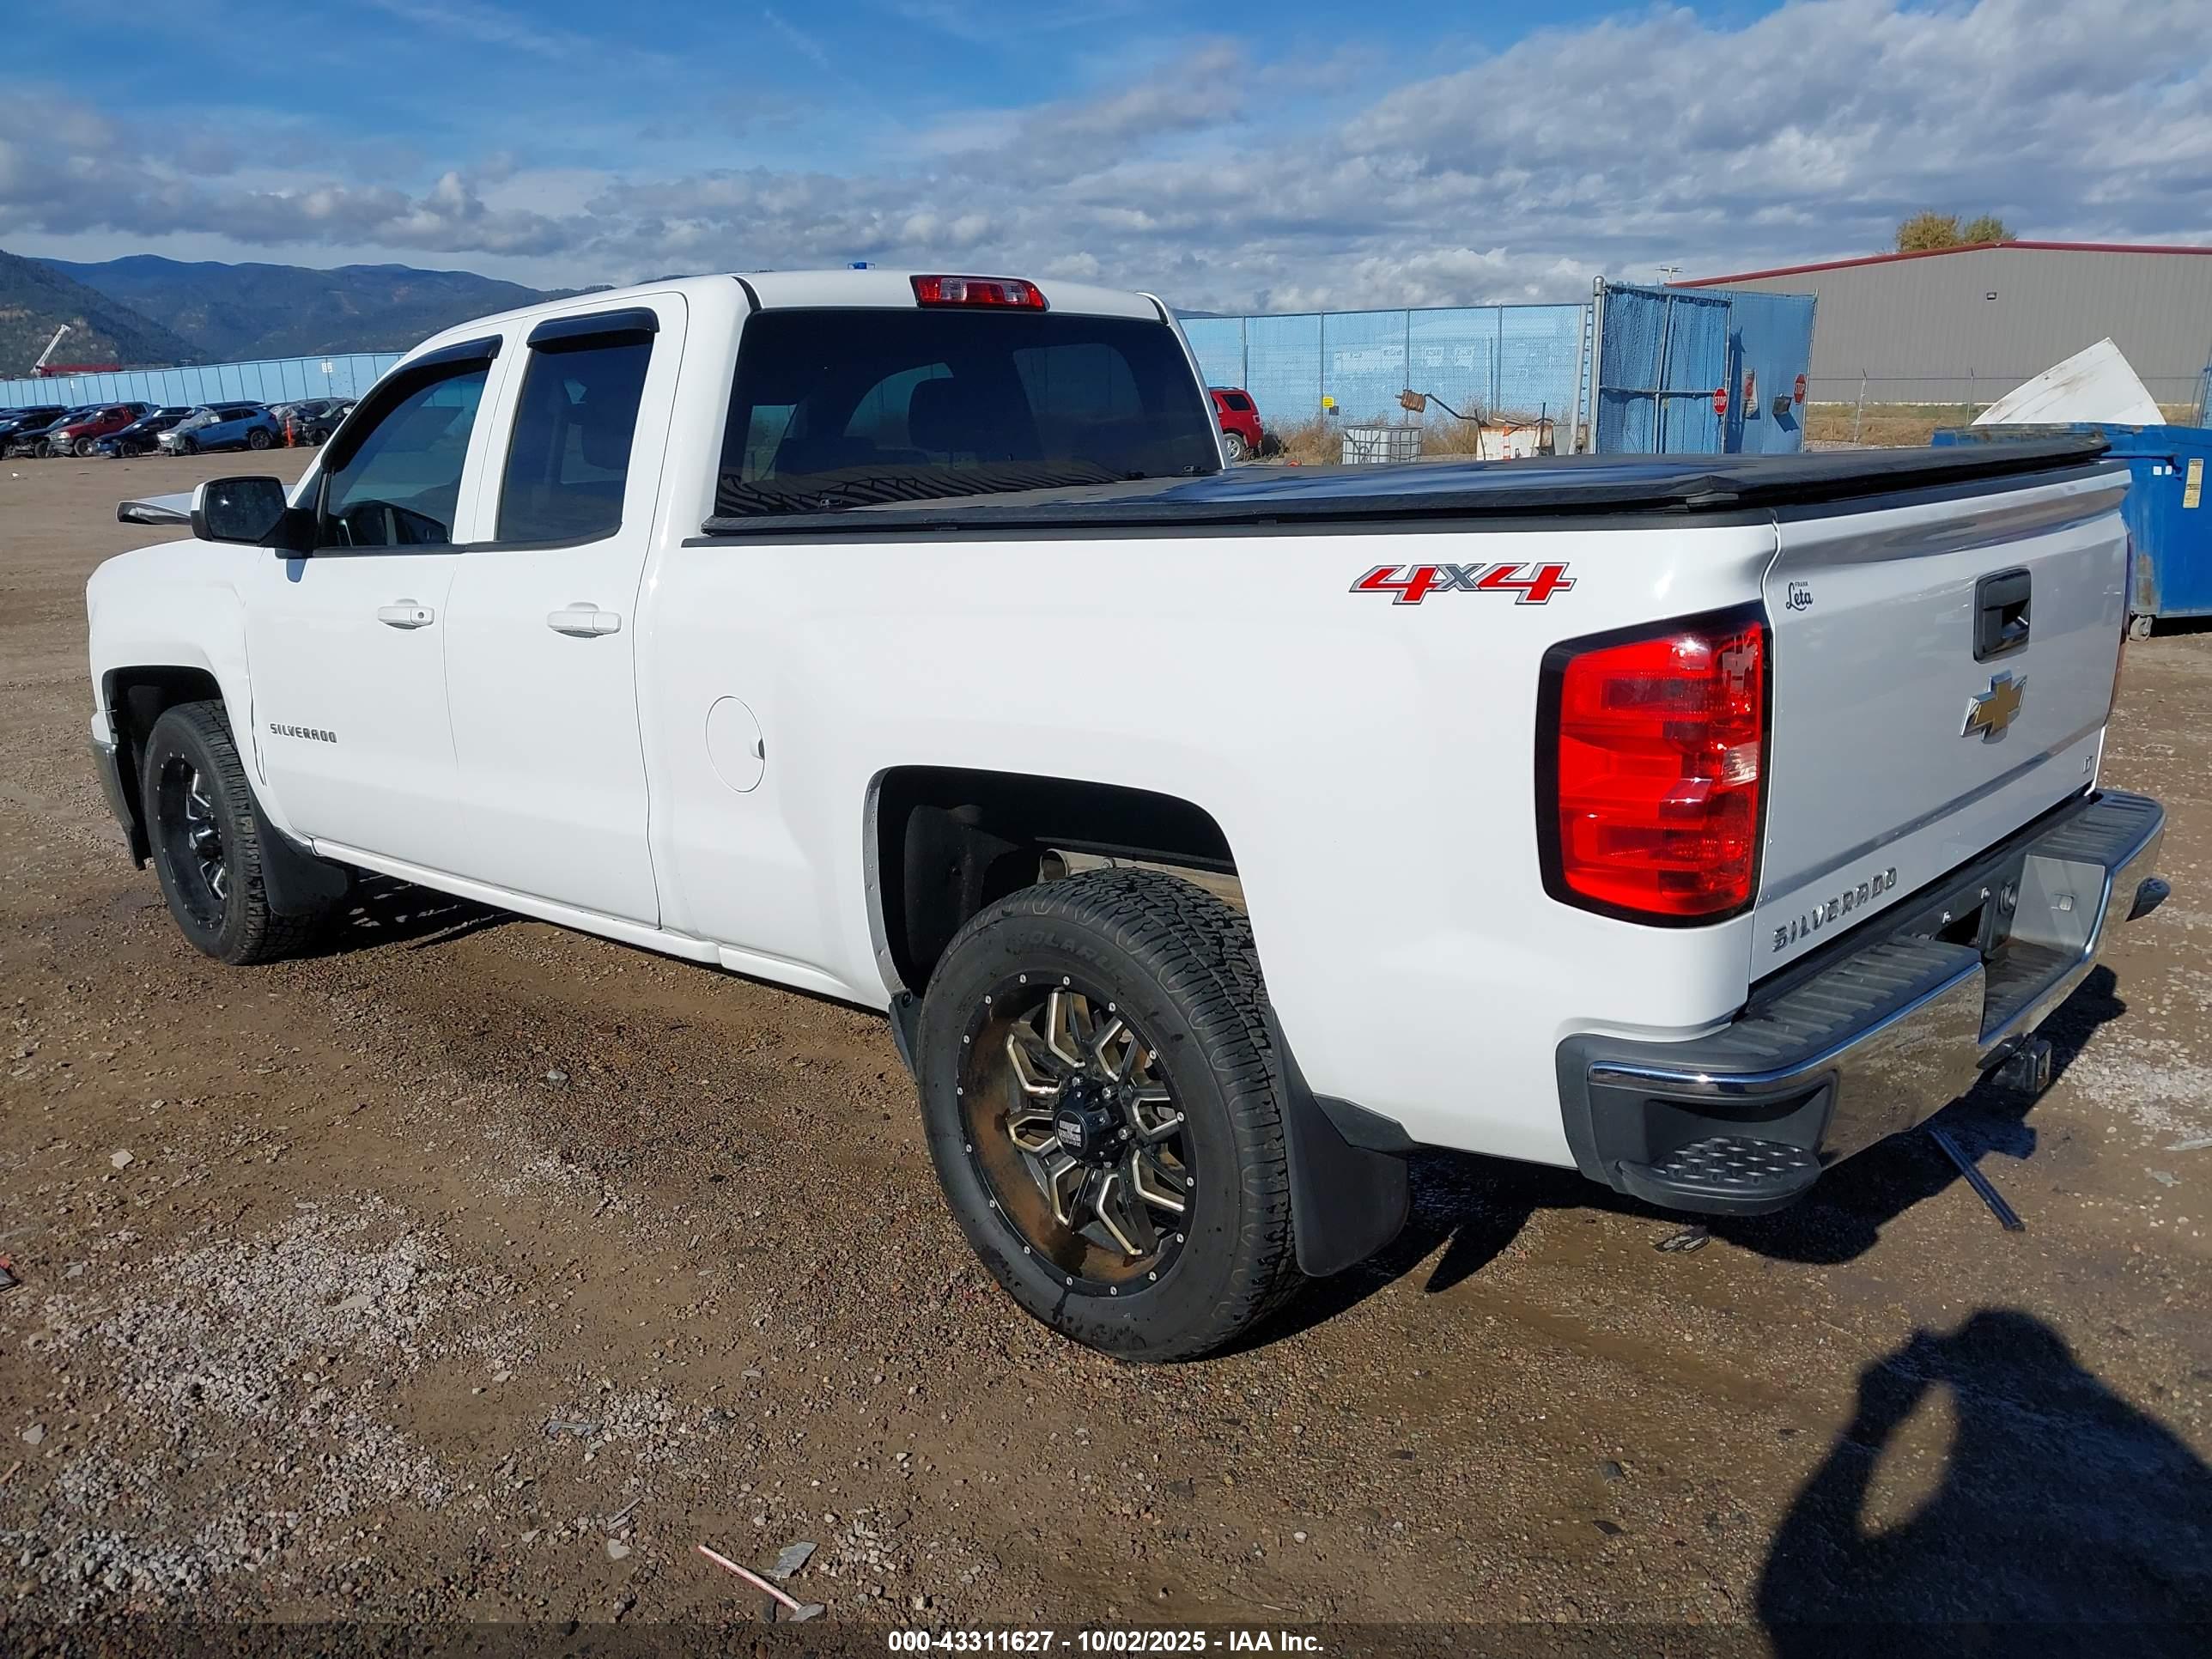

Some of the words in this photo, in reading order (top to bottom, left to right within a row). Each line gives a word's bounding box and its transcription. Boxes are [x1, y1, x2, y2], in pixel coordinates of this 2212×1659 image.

[1796, 382, 1806, 394] STOP
[1714, 396, 1726, 406] STOP
[270, 723, 337, 744] SILVERADO
[1771, 866, 1898, 952] SILVERADO
